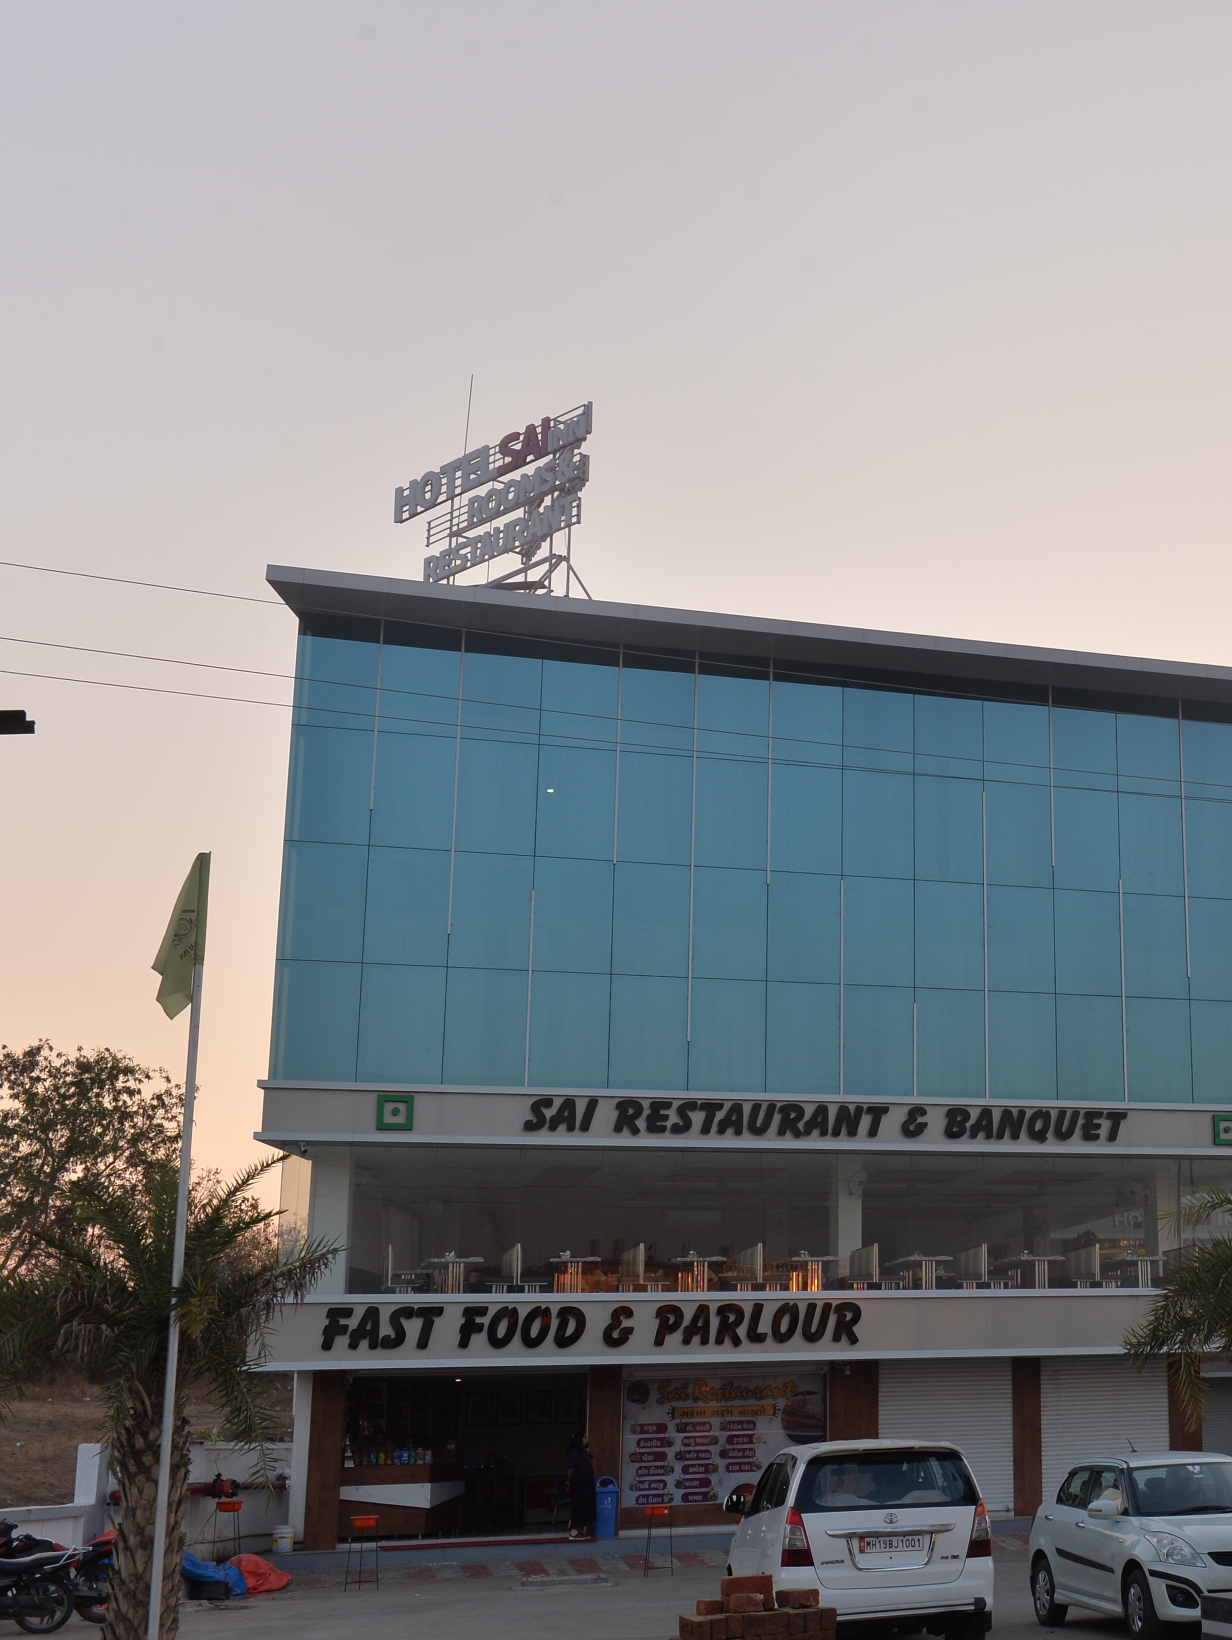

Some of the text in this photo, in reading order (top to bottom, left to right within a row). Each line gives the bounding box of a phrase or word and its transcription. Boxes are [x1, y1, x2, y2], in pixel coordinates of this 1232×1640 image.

[394, 414, 588, 524] HOTEL SAI INN
[467, 452, 577, 526] ROOMS &
[423, 494, 579, 583] RESTAURANT
[524, 1097, 1128, 1143] SAI RESTAURANT & BANQUET
[321, 1302, 861, 1351] FAST FOOD & PARLOUR
[658, 1379, 796, 1403] Sai Restaurant
[866, 1537, 921, 1550] MH19BJ1001
